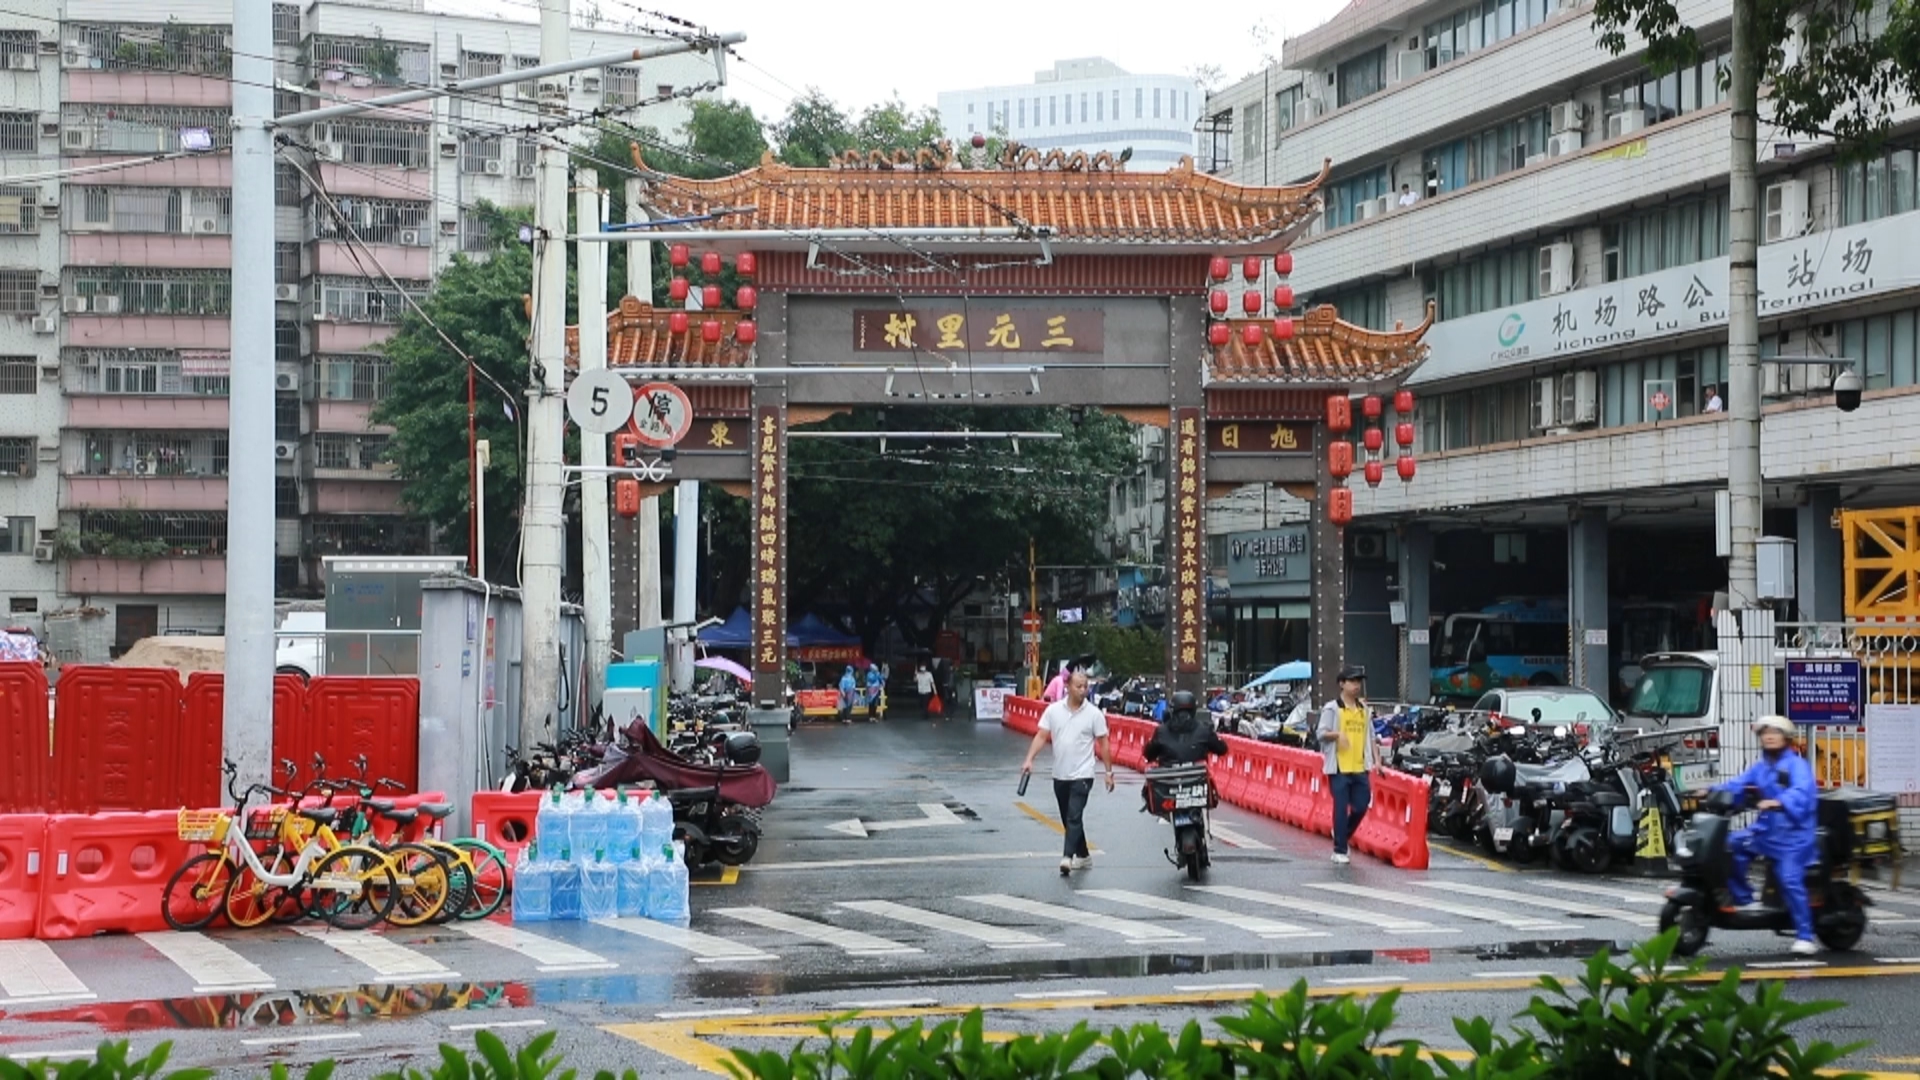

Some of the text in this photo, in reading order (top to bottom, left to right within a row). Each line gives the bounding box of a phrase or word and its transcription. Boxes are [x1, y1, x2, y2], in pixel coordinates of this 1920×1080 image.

[1552, 238, 1874, 337] 机场路公站场
[1553, 278, 1874, 351] Jichang Lu Bu Terminal
[884, 313, 1074, 349] 三元里村
[590, 386, 609, 416] 5
[648, 391, 672, 420] 停
[707, 420, 733, 448] 東
[1221, 424, 1298, 449] 旭日
